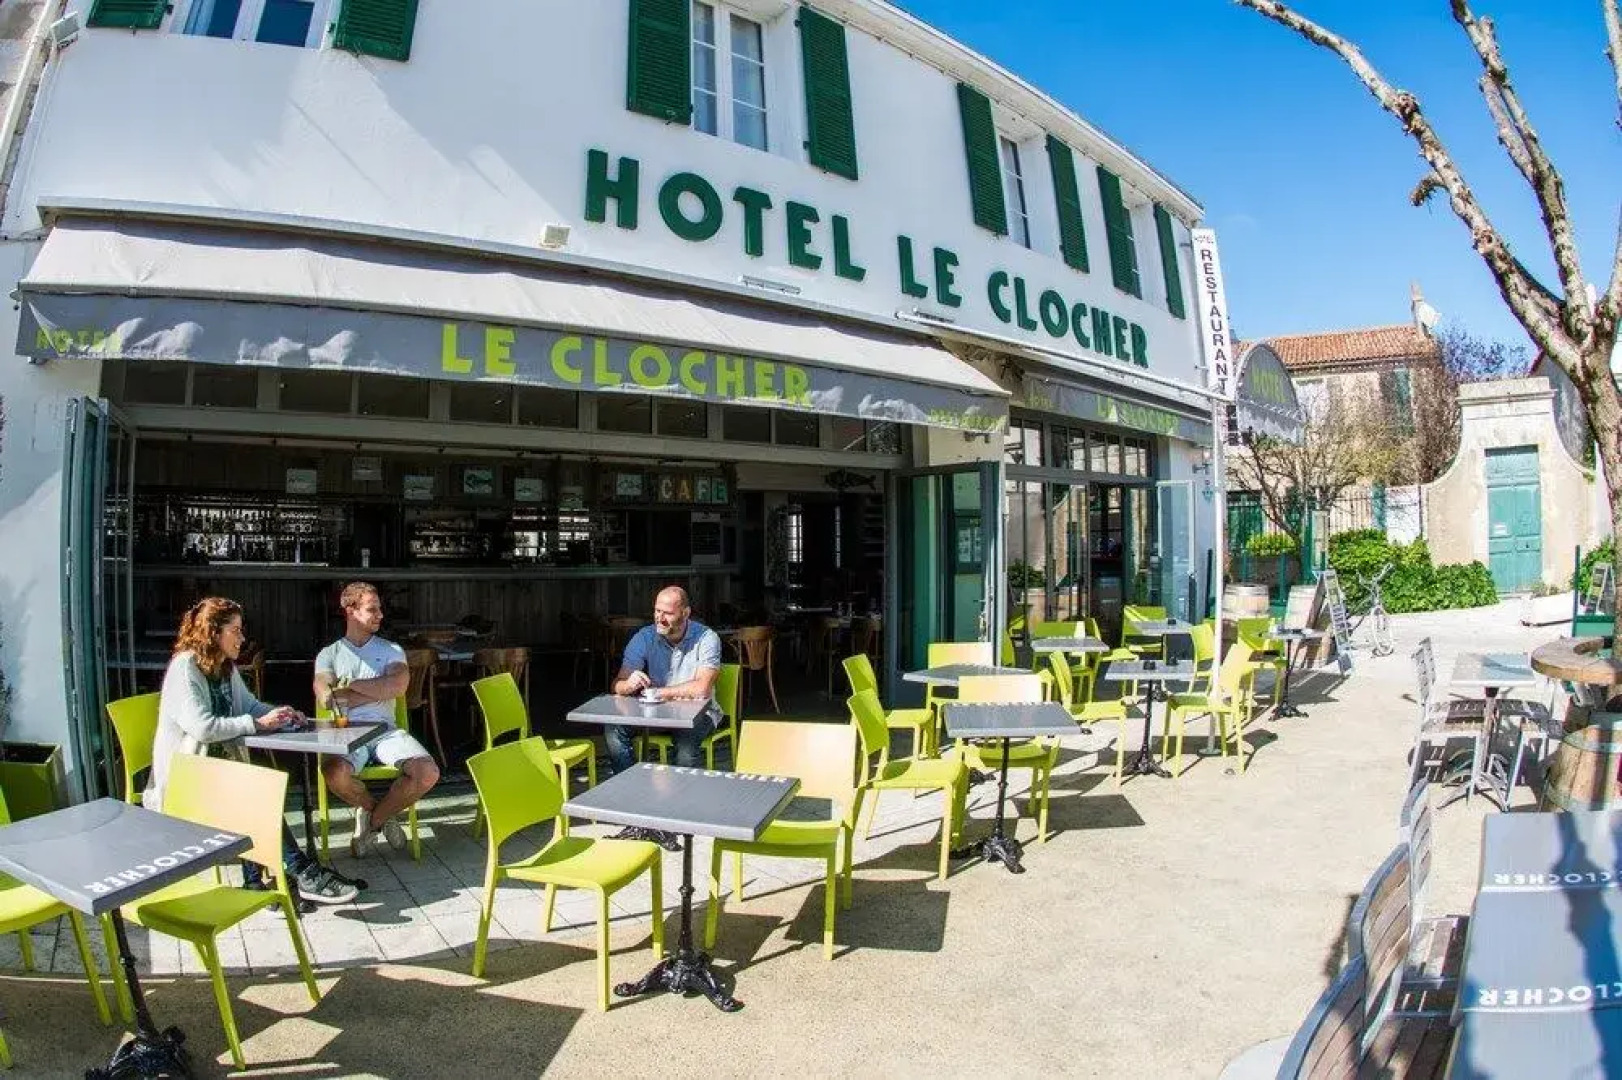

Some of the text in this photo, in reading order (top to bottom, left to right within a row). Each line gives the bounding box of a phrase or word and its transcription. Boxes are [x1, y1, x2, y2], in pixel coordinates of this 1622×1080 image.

[585, 148, 1149, 368] HOTEL LE CLOCHER
[1201, 249, 1229, 396] RESTAURANT
[442, 324, 813, 408] LE CLOCHER
[674, 767, 788, 783] CLOCHER
[84, 833, 237, 893] LE CLOCHER
[1493, 872, 1612, 885] CLOCHER
